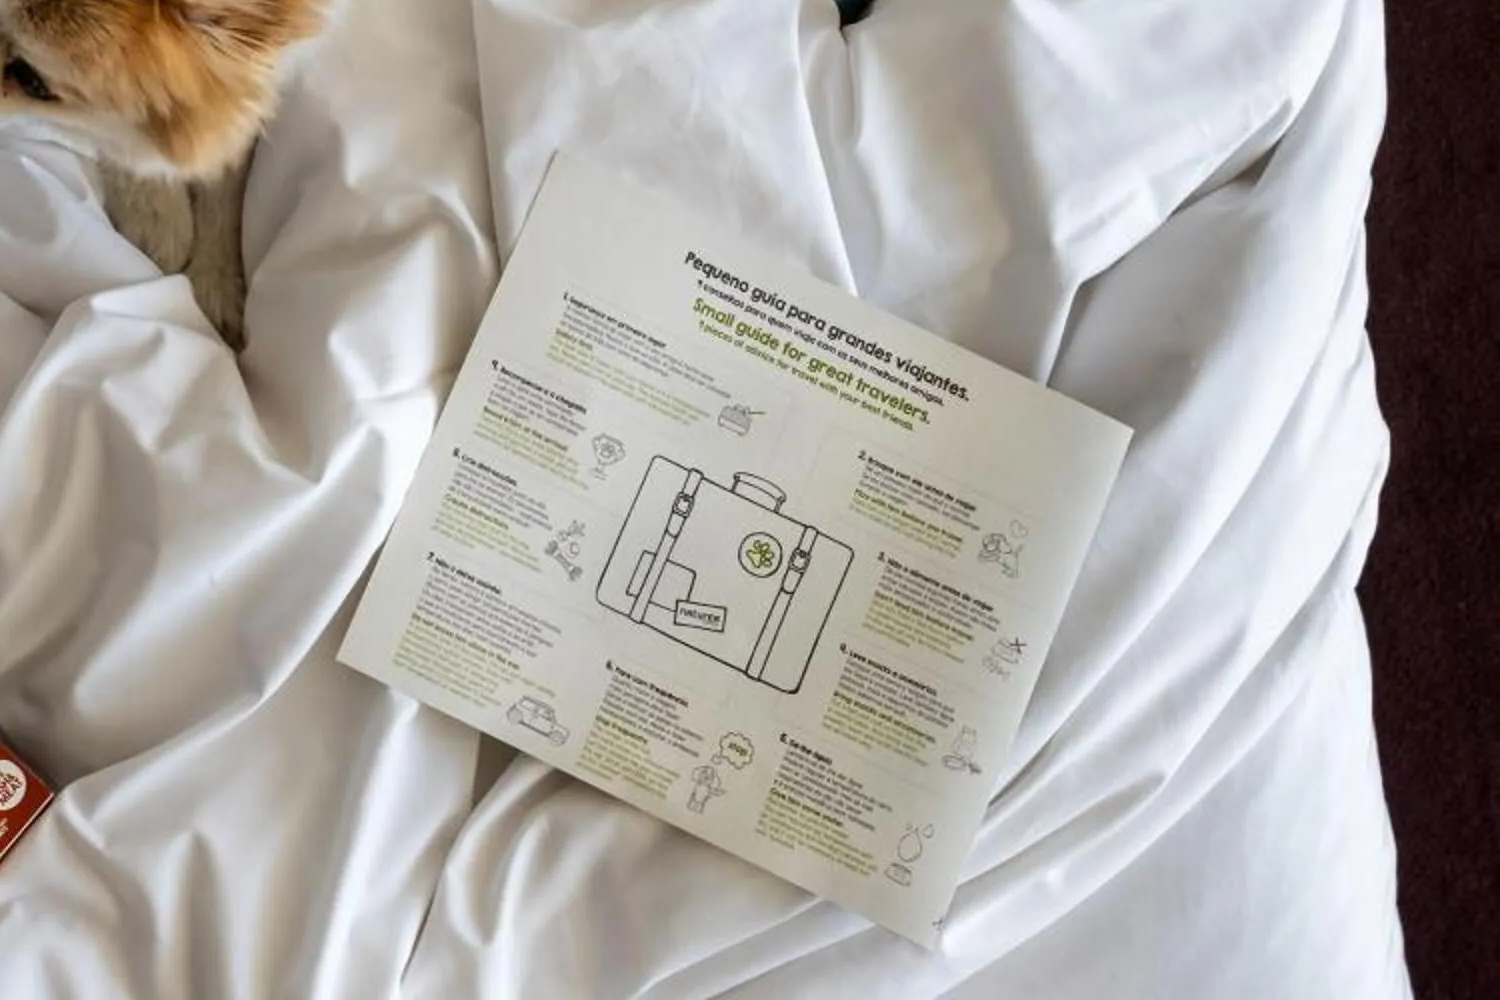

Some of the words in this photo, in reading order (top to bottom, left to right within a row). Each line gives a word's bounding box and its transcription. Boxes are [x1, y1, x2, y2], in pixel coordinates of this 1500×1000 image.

[682, 251, 750, 295] Pequeno
[748, 284, 788, 313] guia
[785, 303, 828, 332] para
[825, 321, 894, 364] grandes
[893, 354, 973, 402] viajantes.
[691, 296, 736, 329] Small
[733, 319, 781, 350] guide
[780, 341, 806, 363] for
[806, 355, 854, 387] great
[854, 377, 934, 425] travelers.
